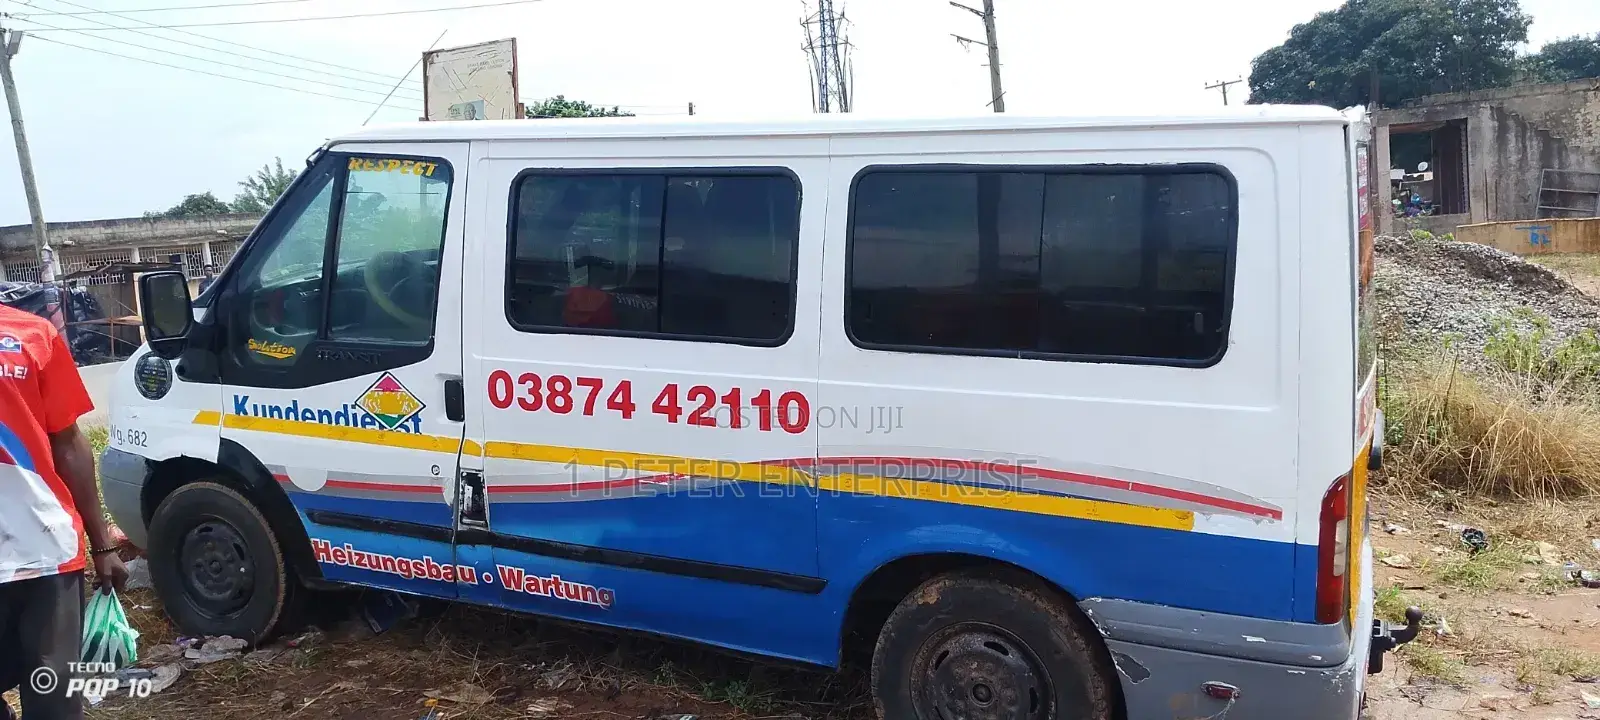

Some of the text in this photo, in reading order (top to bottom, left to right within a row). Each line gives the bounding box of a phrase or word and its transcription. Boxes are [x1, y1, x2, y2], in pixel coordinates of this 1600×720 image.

[348, 157, 438, 177] RESPECT
[486, 369, 812, 435] 03874 42110
[128, 428, 148, 448] 682
[311, 538, 615, 610] Heizungsbau Wartung
